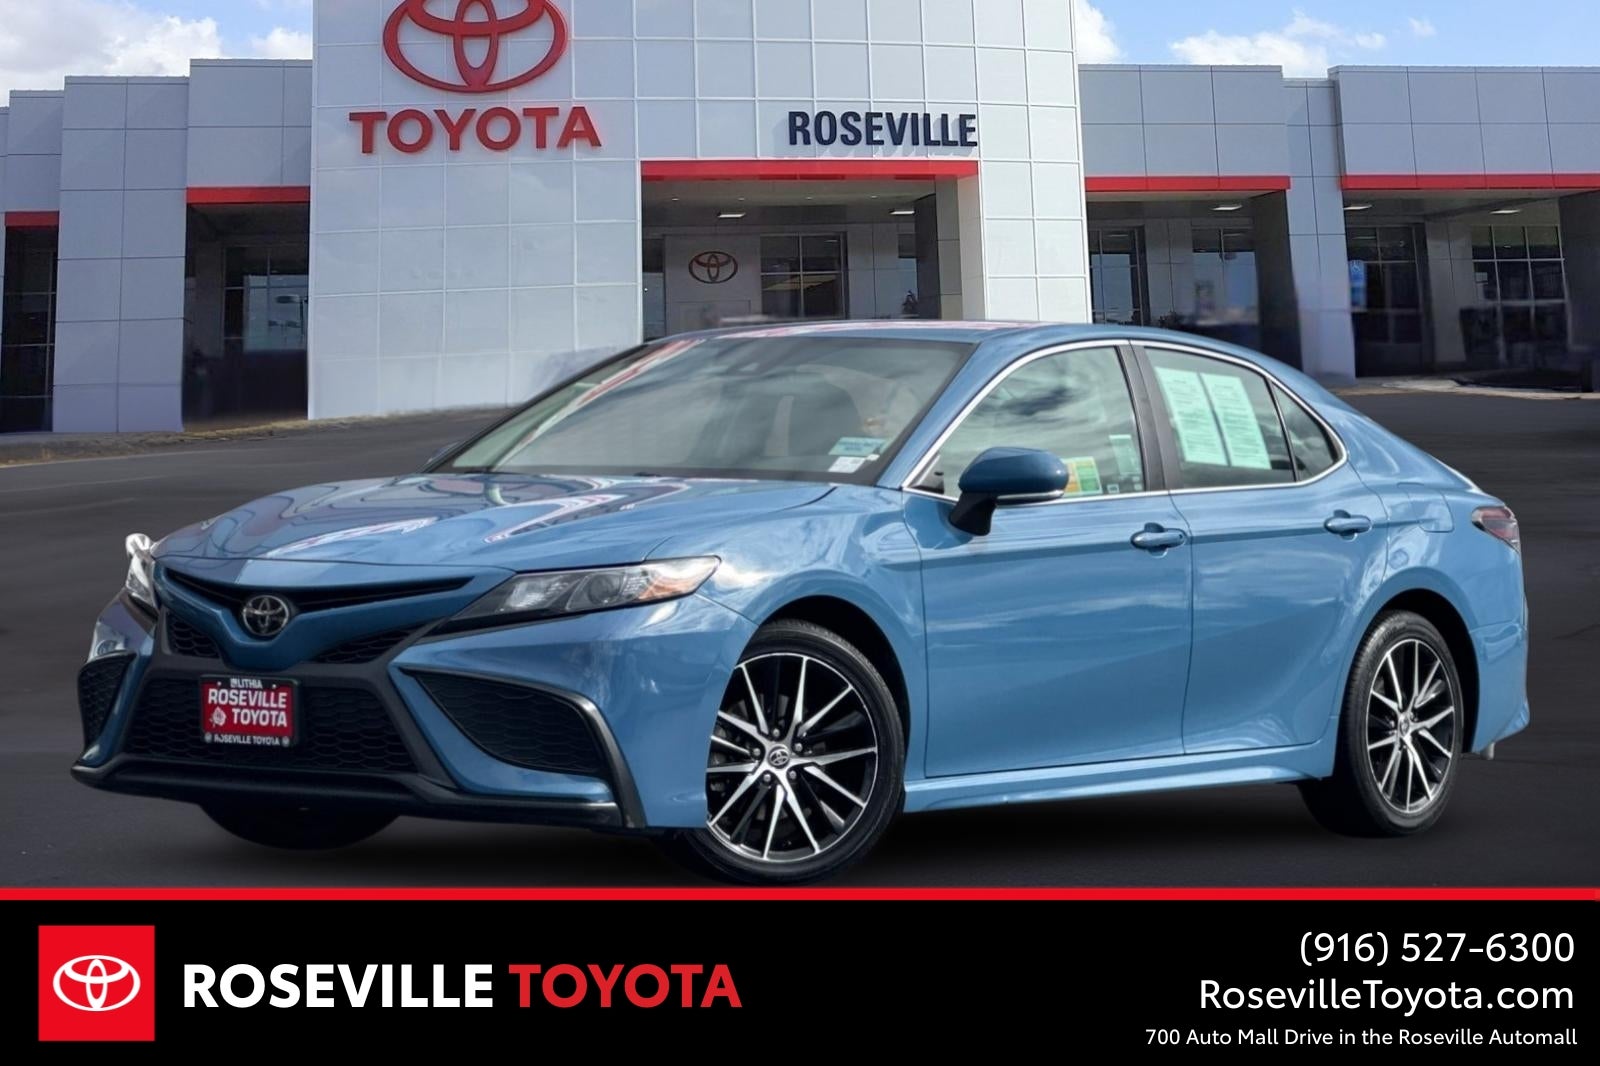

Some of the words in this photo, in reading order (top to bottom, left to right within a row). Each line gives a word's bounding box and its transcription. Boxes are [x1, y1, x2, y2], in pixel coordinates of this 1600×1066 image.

[349, 106, 602, 154] TOYOTA
[788, 110, 978, 148] ROSEVILLE
[237, 678, 263, 689] LITHIA
[208, 688, 288, 708] ROSEVILLE
[232, 708, 288, 727] TOYOTA
